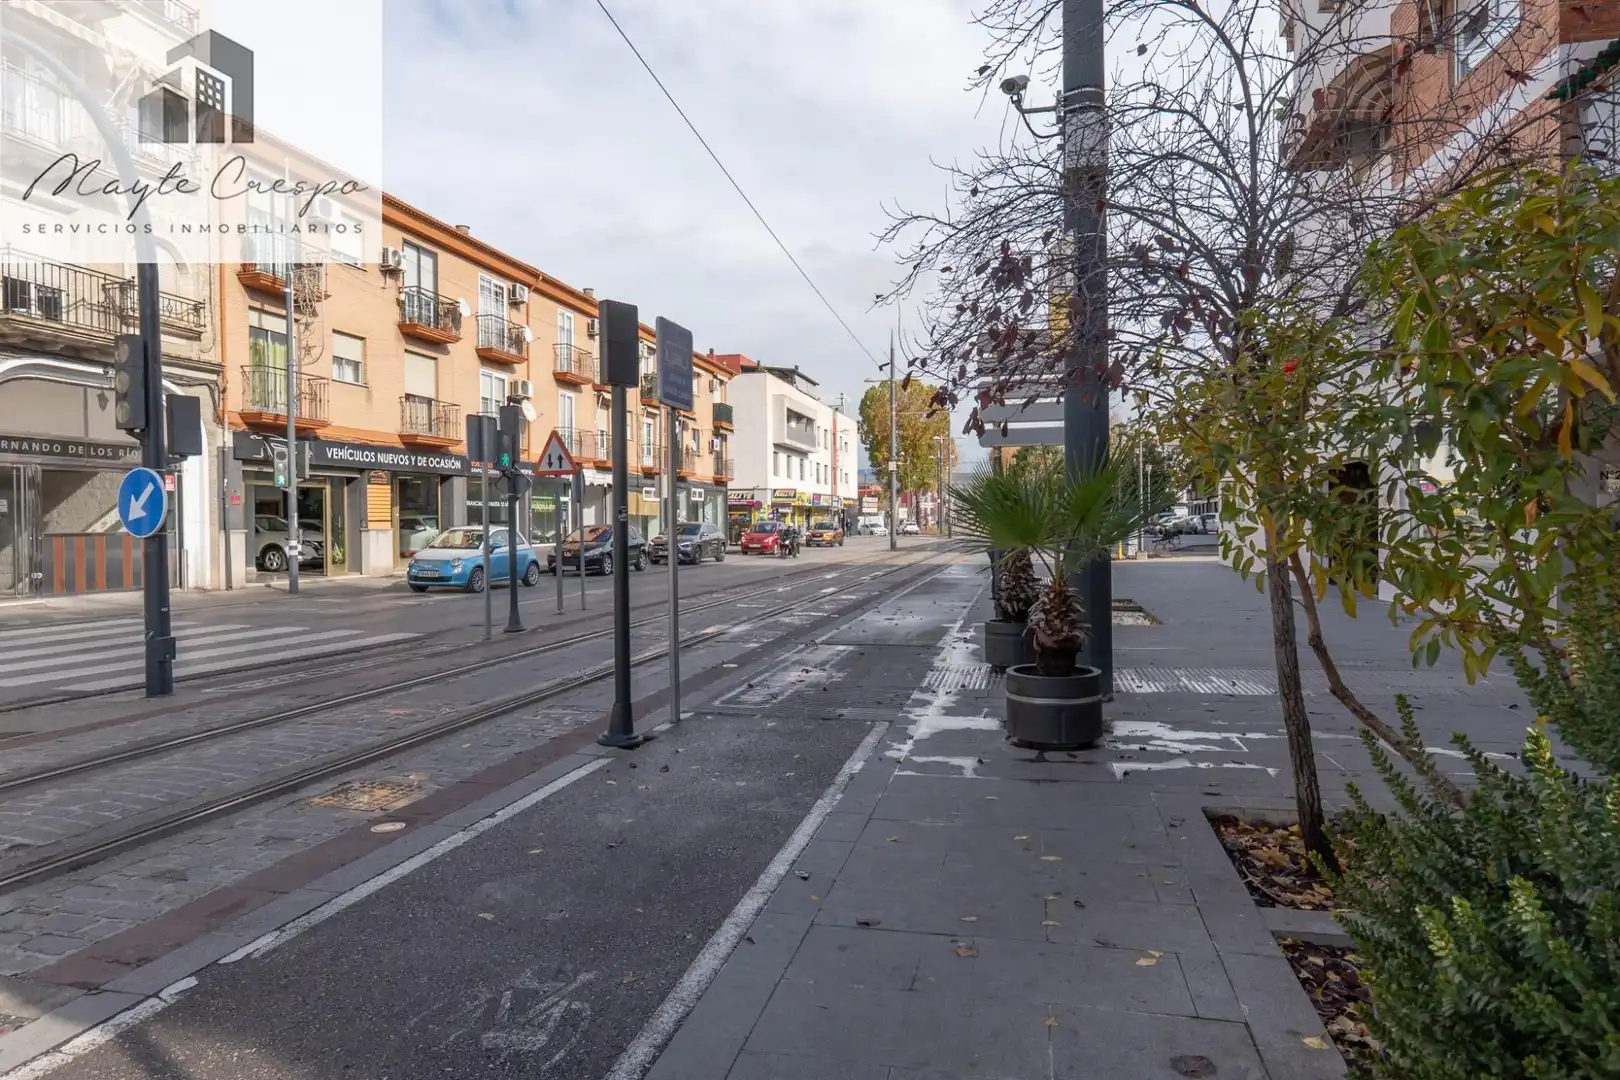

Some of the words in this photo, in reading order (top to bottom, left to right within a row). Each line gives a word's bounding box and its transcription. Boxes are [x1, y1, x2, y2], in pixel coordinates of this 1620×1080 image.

[69, 445, 85, 455] DE
[91, 447, 112, 457] LOS
[326, 445, 376, 463] VEHÍCULOS
[377, 452, 409, 466] NUEVOS
[410, 455, 416, 466] Y
[417, 456, 428, 467] DE
[428, 456, 462, 470] OCASIÓN
